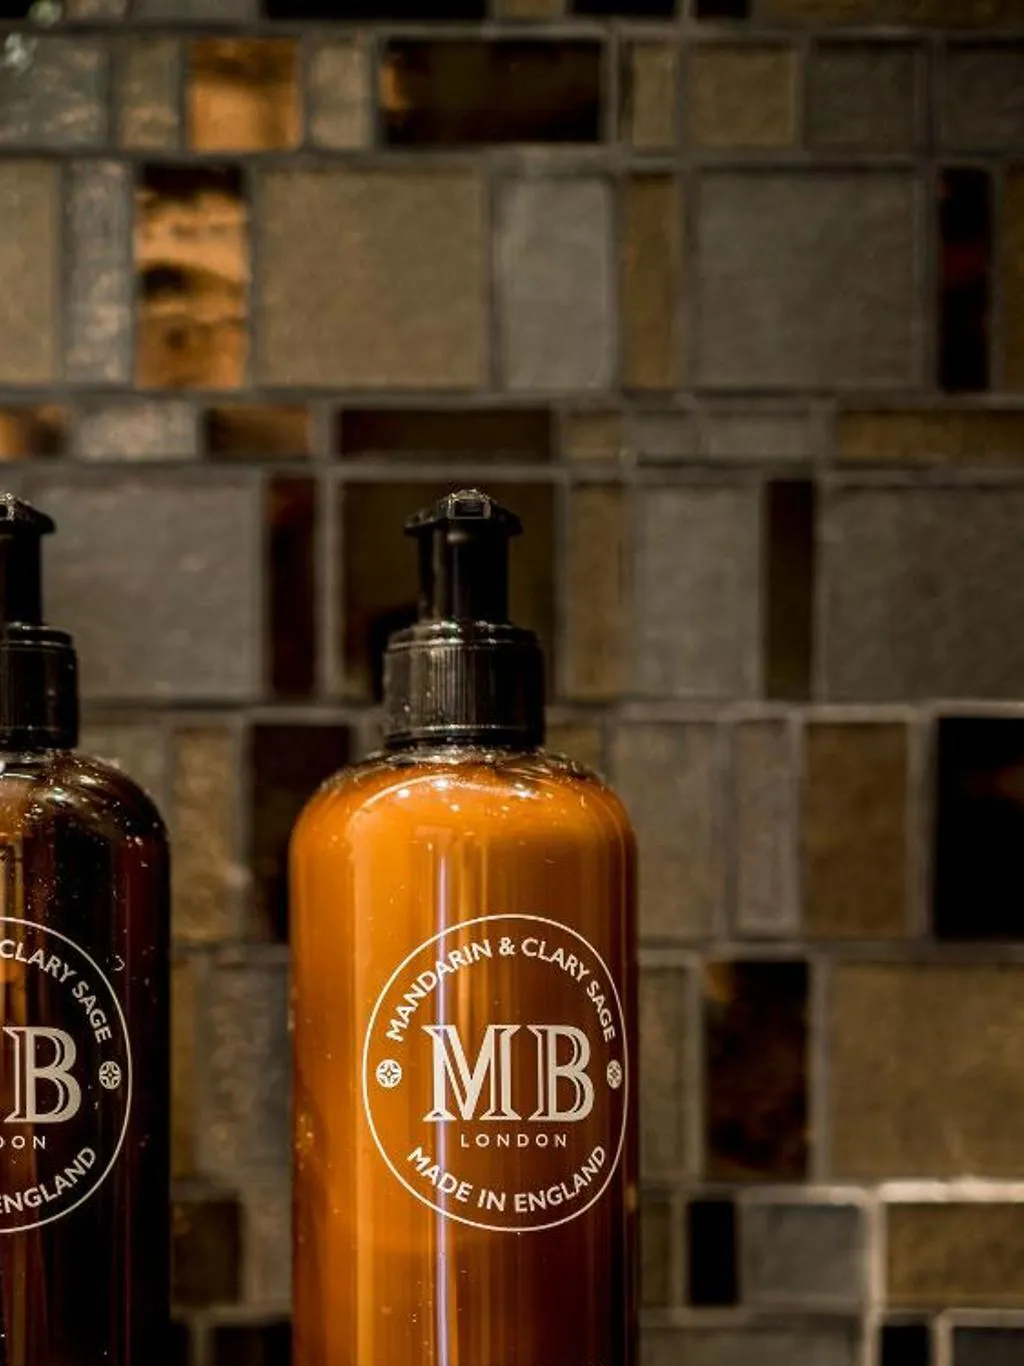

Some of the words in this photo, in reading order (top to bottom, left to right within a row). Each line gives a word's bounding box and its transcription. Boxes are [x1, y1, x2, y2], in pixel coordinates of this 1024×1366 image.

[71, 980, 113, 1043] SAGE
[385, 938, 493, 1042] MANDARIN
[498, 937, 516, 956] &
[521, 937, 590, 983] CLARY
[586, 980, 616, 1043] SAGE
[421, 1024, 595, 1122] MB
[460, 1133, 567, 1148] LONDON
[407, 1146, 473, 1203] MADE
[477, 1188, 505, 1212] IN
[515, 1145, 607, 1213] ENGLAND
